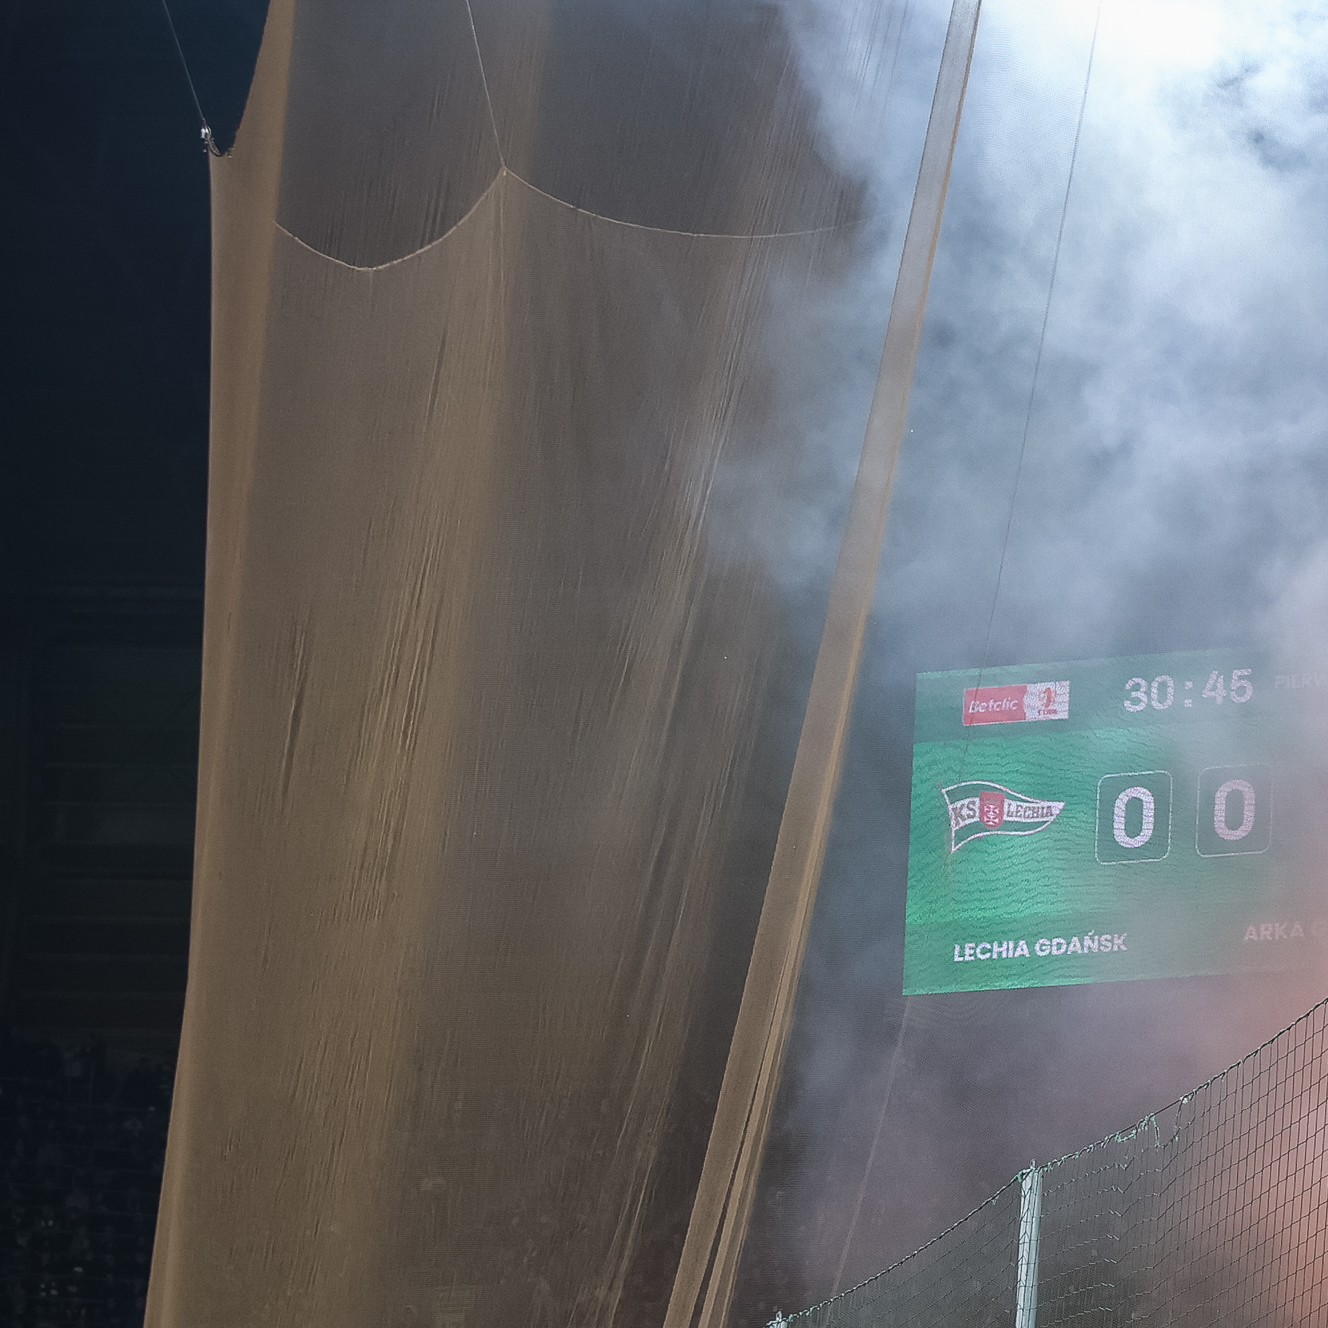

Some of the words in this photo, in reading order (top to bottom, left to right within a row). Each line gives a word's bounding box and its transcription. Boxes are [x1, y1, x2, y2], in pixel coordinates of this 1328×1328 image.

[968, 697, 1018, 714] Betclic
[1123, 668, 1253, 713] 30:45
[1112, 786, 1155, 849] 0
[1214, 779, 1256, 841] 0
[953, 938, 1030, 962] LECHIA
[1034, 930, 1128, 957] GDAŃSK
[1243, 921, 1305, 941] ARKA
